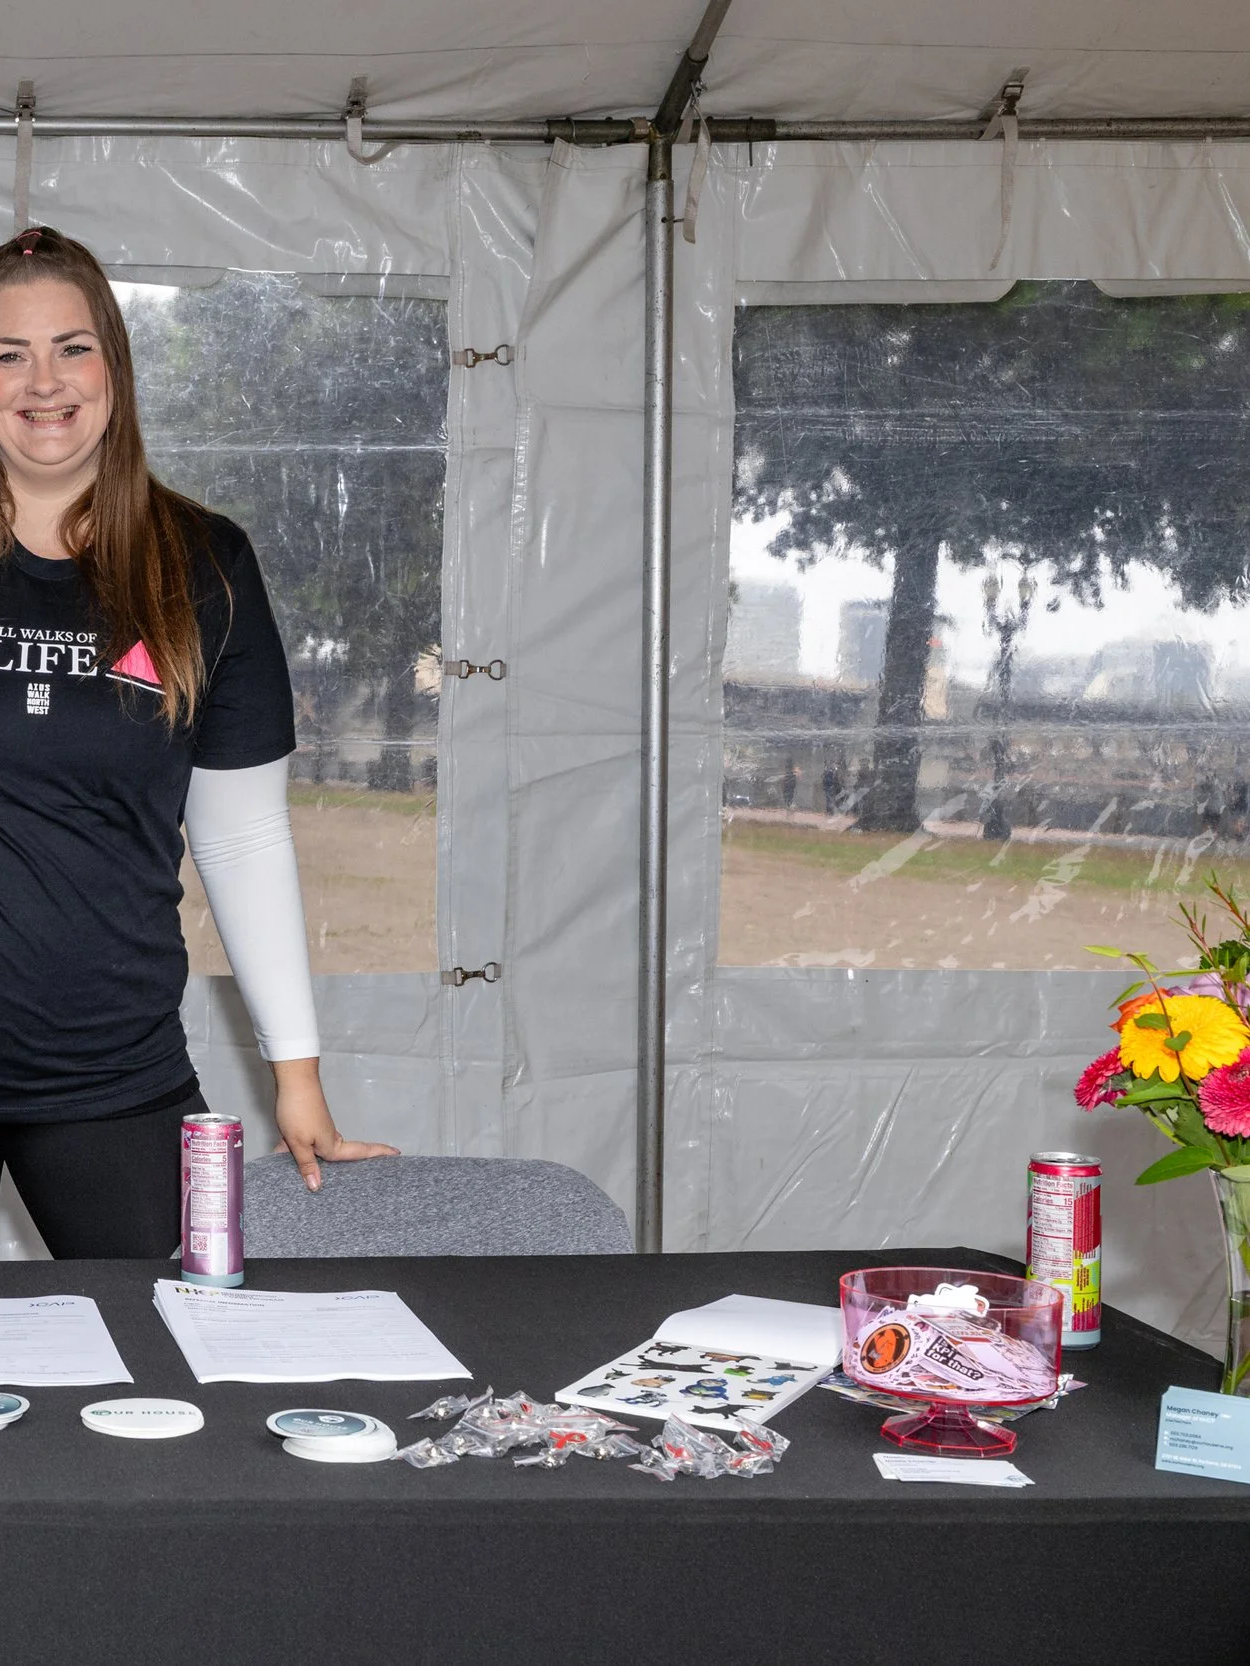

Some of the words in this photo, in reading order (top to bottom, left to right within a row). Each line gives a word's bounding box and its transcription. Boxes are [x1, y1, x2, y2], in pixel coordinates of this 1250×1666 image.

[20, 628, 74, 642] WALKS
[76, 632, 98, 643] OF
[27, 683, 50, 691] AIDS
[27, 690, 50, 698] WALK
[27, 698, 50, 706] NORTH
[27, 706, 49, 715] WEST
[1056, 1181, 1073, 1189] Facts
[1064, 1198, 1073, 1206] 15
[927, 1349, 947, 1362] for
[947, 1359, 982, 1380] that?
[1166, 1405, 1190, 1414] Megan
[1191, 1408, 1219, 1418] Chaney
